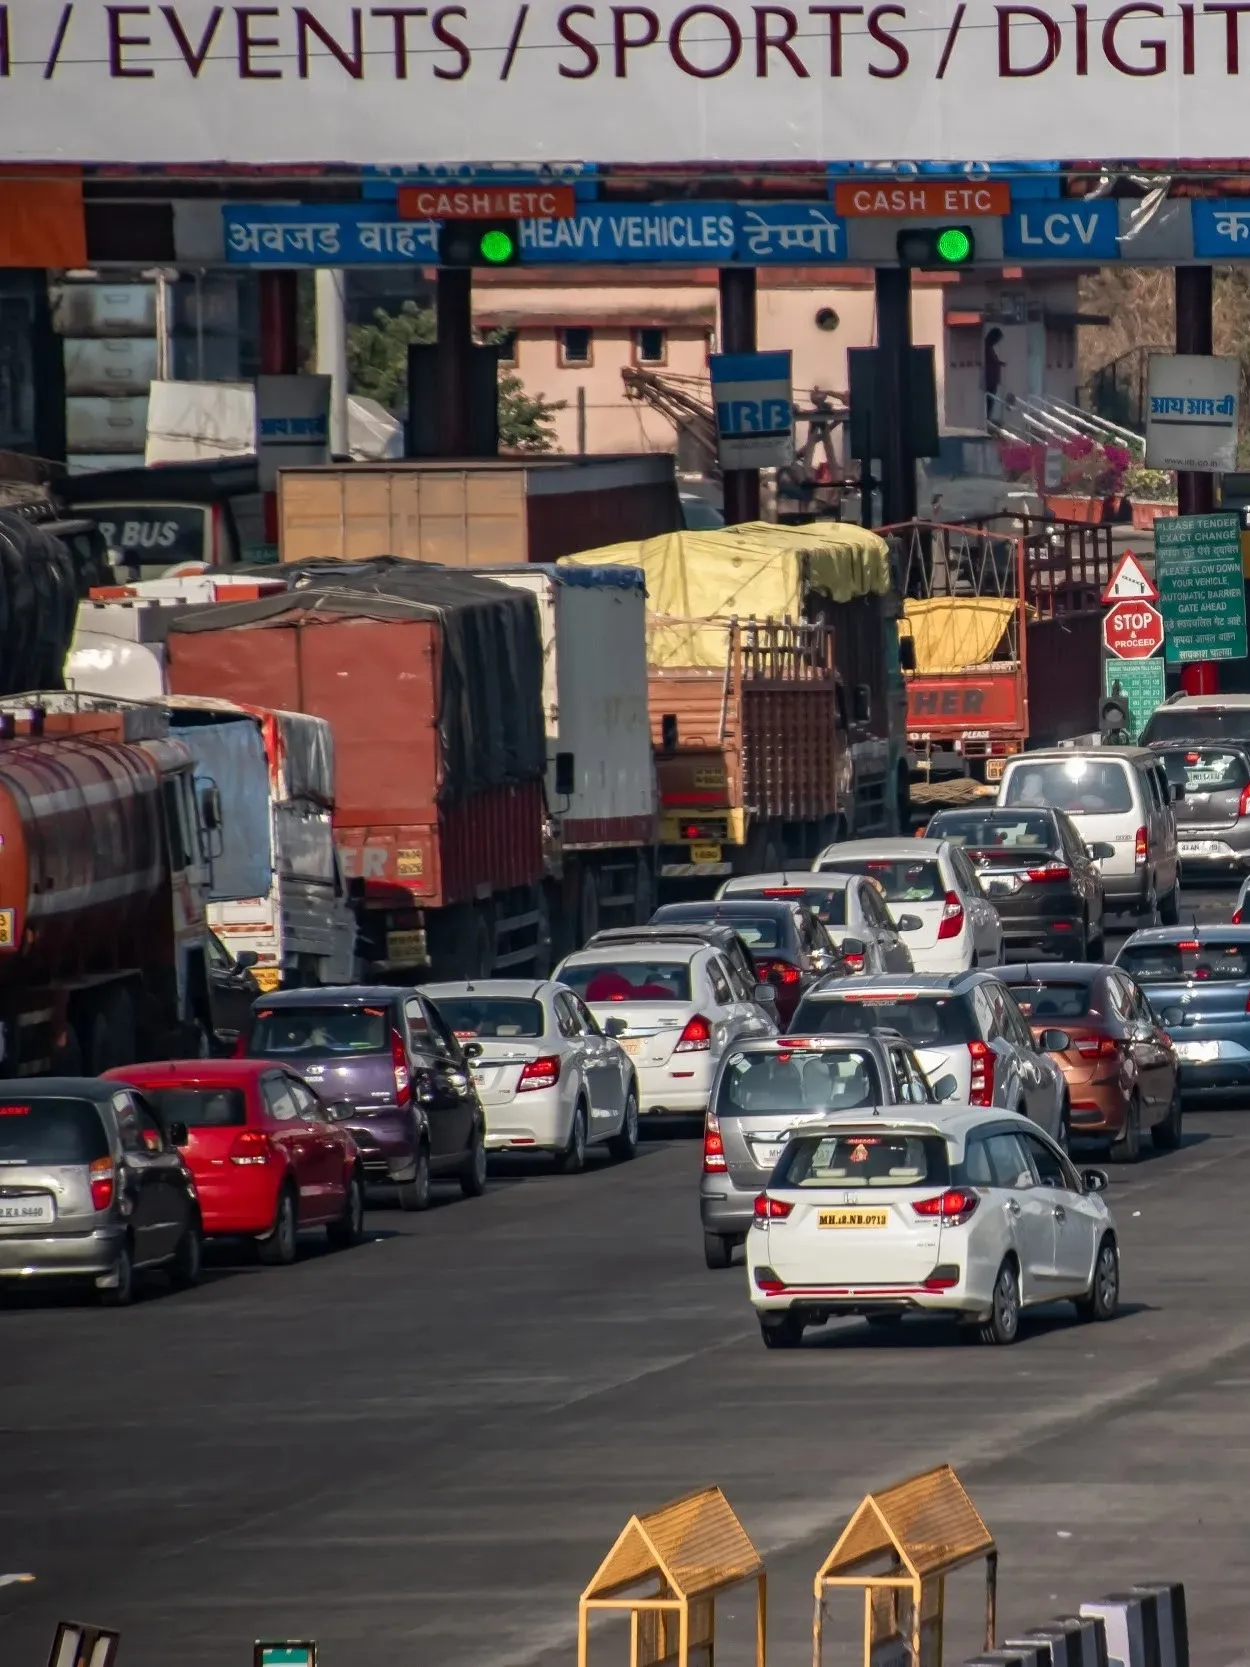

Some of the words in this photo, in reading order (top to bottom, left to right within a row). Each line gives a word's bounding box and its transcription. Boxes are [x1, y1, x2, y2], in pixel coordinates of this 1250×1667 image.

[109, 5, 471, 79] EVENTS
[558, 4, 909, 79] SPORTS
[417, 193, 489, 215] CASH
[508, 192, 557, 213] ETC
[853, 190, 926, 211] CASH
[944, 190, 991, 210] ETC
[229, 222, 340, 253] अवजड
[519, 216, 603, 248] HEAVY
[609, 216, 735, 247] VEHICLES
[743, 209, 840, 254] टेम्पो
[1020, 213, 1099, 244] LCV
[717, 399, 791, 432] IRB
[121, 521, 180, 547] BUS
[1156, 520, 1195, 531] PLEASE
[1196, 518, 1237, 528] TENDER
[1159, 533, 1192, 543] EXACT
[1194, 530, 1237, 540] CHANGE
[1160, 565, 1191, 576] PLEASE
[1192, 564, 1216, 574] SLOW
[1216, 563, 1241, 573] DOWN
[1171, 578, 1194, 588] YOUR
[1161, 591, 1206, 601] AUTOMATIC
[1207, 589, 1241, 599] BARRIER
[1178, 603, 1199, 613] GATE
[1200, 602, 1227, 612] AHEAD
[1114, 612, 1153, 631] STOP
[1115, 639, 1155, 648] PROCEED
[1130, 631, 1138, 639] &
[961, 731, 990, 739] PLEASE
